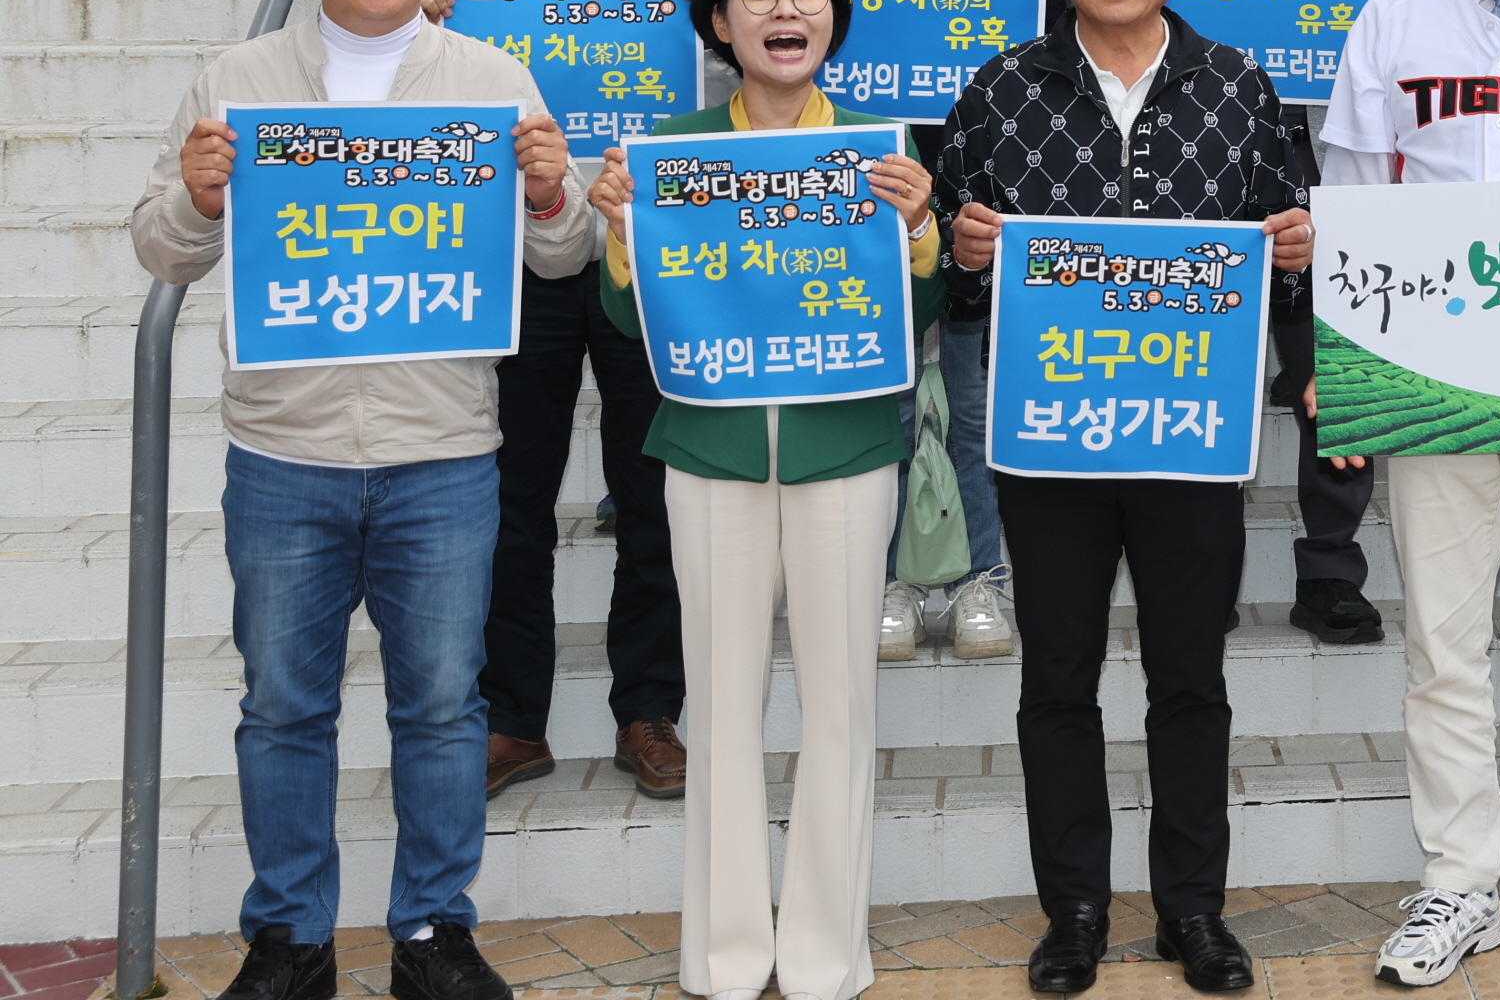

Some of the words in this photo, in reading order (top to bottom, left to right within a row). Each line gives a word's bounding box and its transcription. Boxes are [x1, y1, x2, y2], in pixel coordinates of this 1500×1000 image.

[598, 67, 676, 103] 유혹,
[820, 61, 900, 106] 보성의
[256, 137, 475, 166] 보성다향대축제
[258, 124, 306, 139] 2024
[309, 128, 340, 137] 제47회
[656, 158, 700, 176] 2024
[702, 162, 731, 173] 제47회
[655, 168, 857, 209] 보성다향대축제
[276, 202, 464, 259] 친구야!
[1029, 238, 1071, 255] 2024
[1074, 244, 1102, 254] 제47회
[658, 242, 728, 281] 보성
[741, 239, 847, 275] 차(茶)의
[1024, 255, 1223, 289] 보성다향대축제
[264, 271, 482, 333] 보성가자
[799, 276, 881, 318] 유혹,
[1329, 250, 1455, 334] 친구야!
[669, 337, 755, 384] 보성의
[764, 331, 885, 375] 프러포즈
[1038, 326, 1211, 382] 친구야!
[1017, 397, 1224, 451] 보성가자
